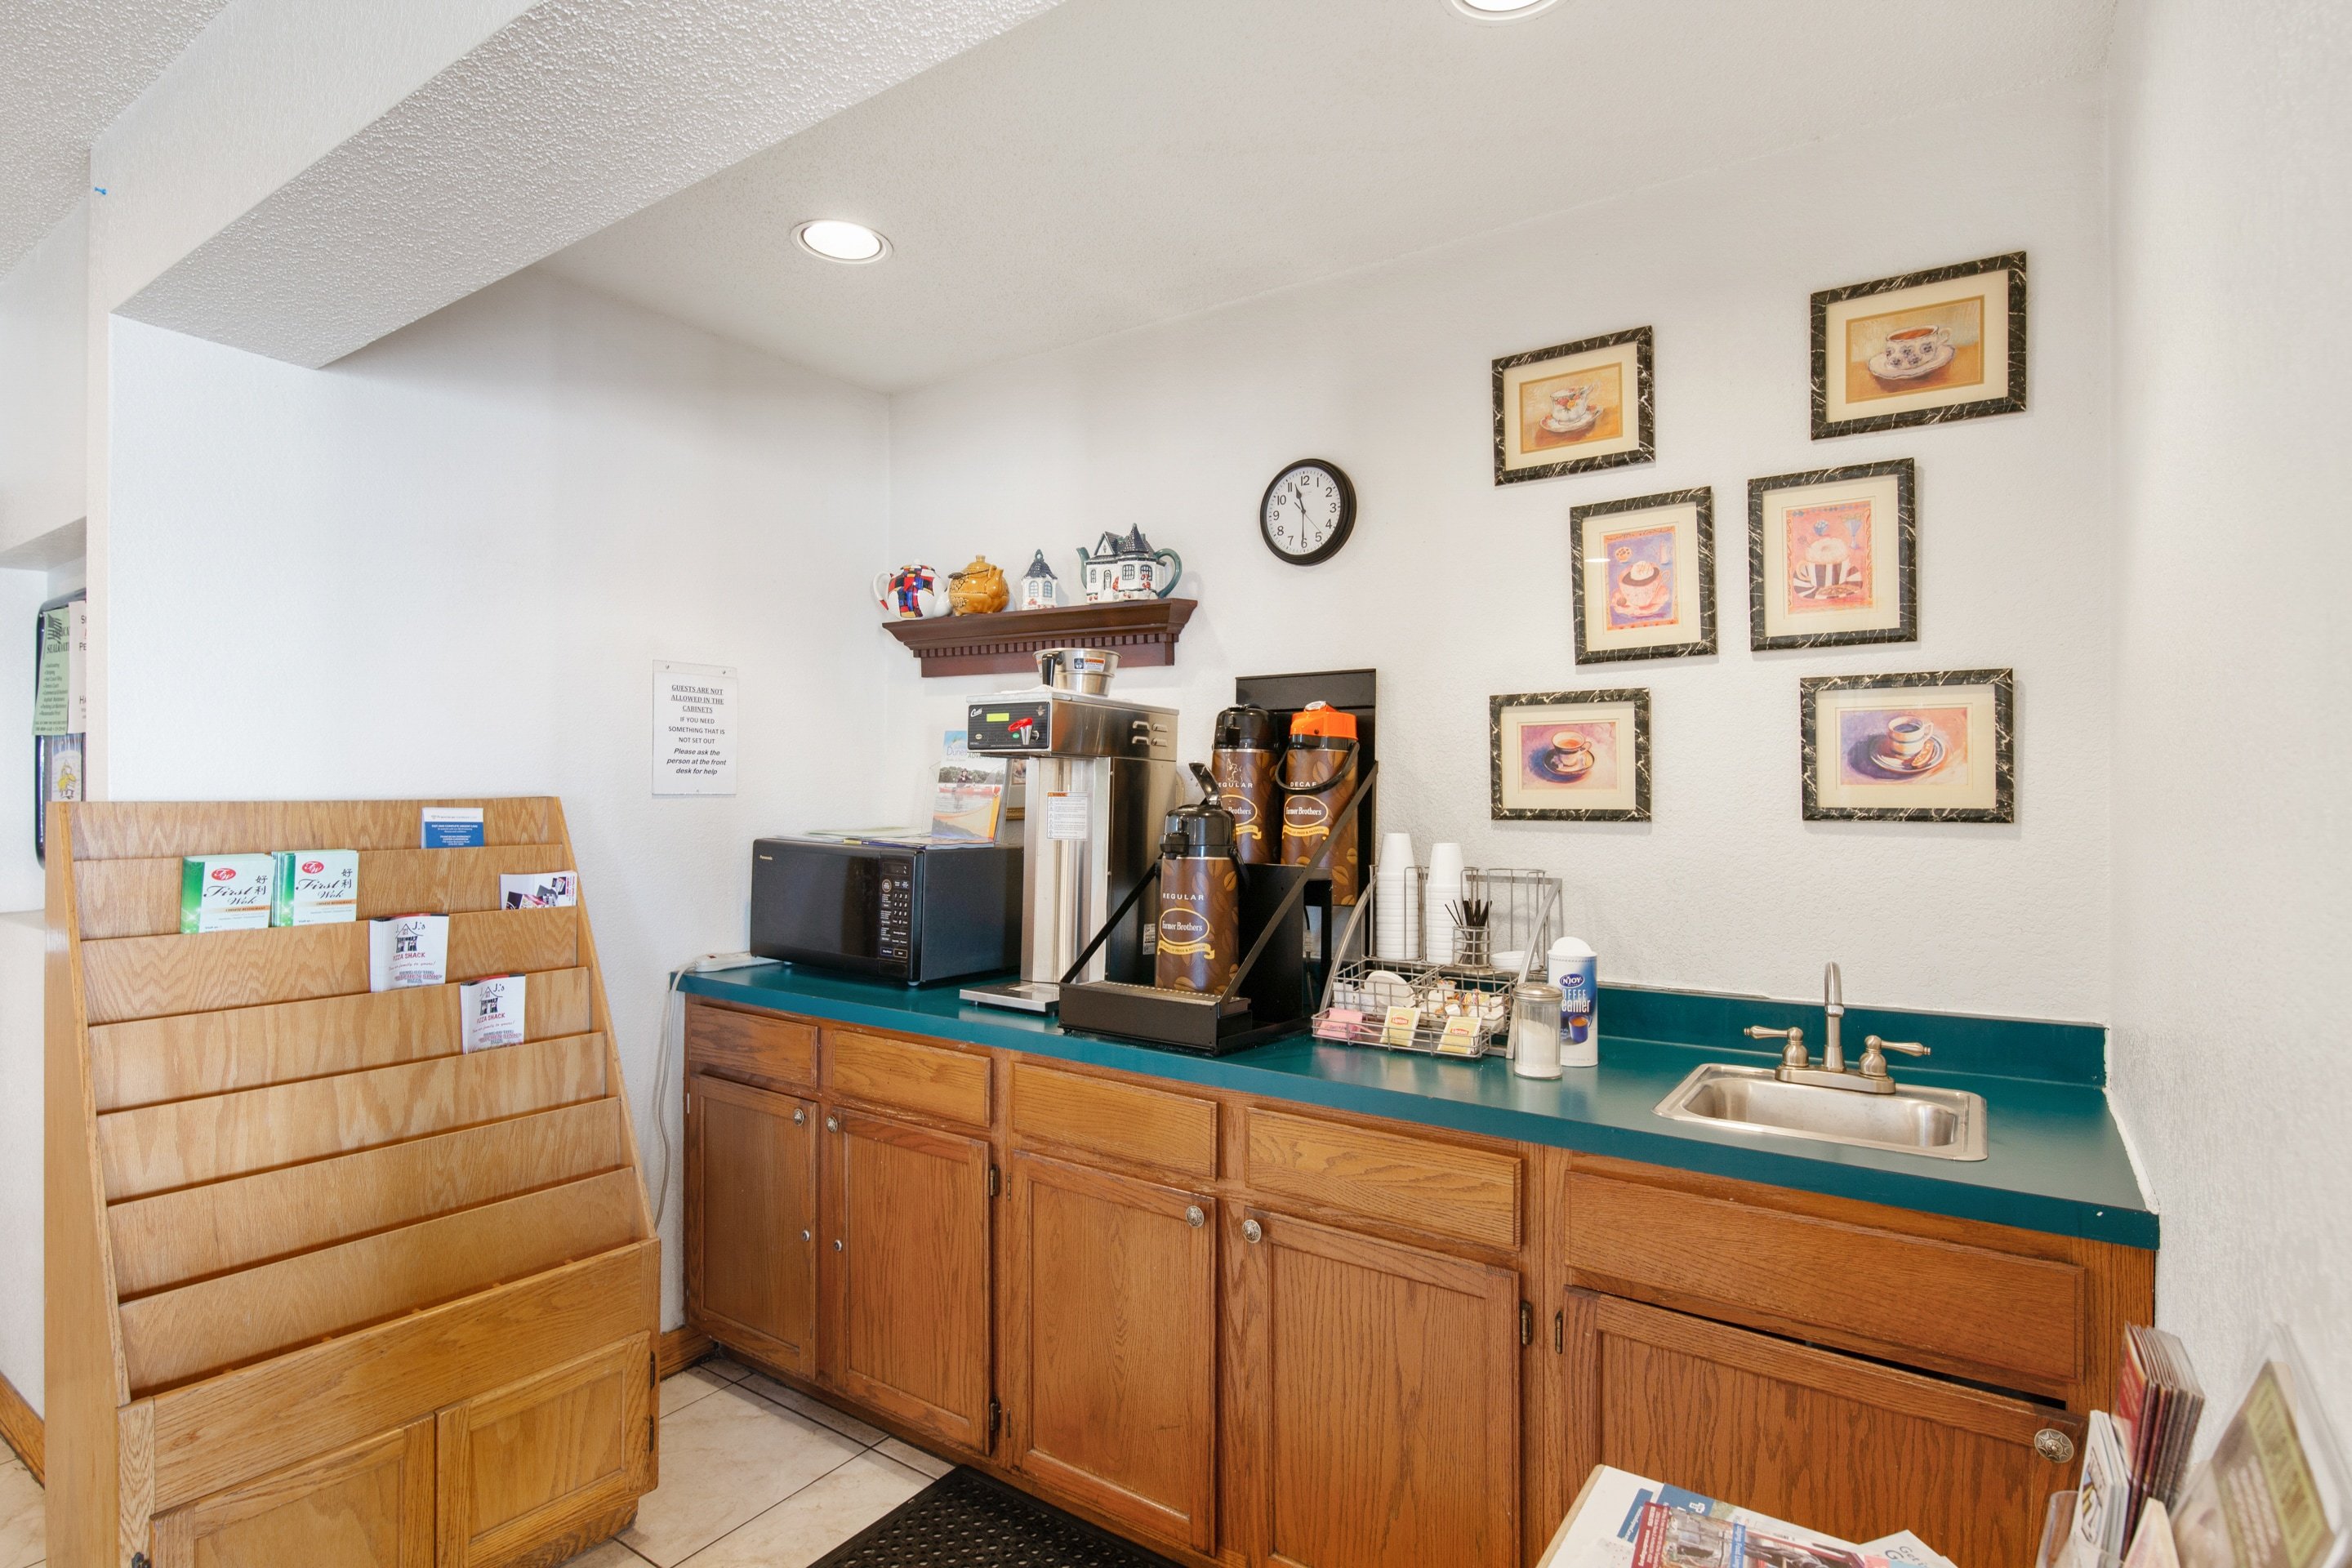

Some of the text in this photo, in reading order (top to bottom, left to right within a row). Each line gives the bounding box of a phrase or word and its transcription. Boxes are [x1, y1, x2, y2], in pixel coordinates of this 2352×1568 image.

[1300, 475, 1310, 486] 12
[1316, 477, 1320, 488] 1
[1288, 482, 1292, 492] 11
[1325, 487, 1333, 497] 2
[1277, 495, 1286, 506] 10
[1330, 503, 1336, 513] 3
[1273, 510, 1279, 520] 9
[1325, 519, 1332, 529] 4
[1277, 526, 1284, 536] 8
[1288, 536, 1294, 546] 7
[1315, 532, 1322, 541] 5
[1301, 538, 1307, 548] 6
[671, 684, 696, 693] GUESTS
[671, 694, 702, 702] ALLOWED
[1228, 807, 1252, 815] Brothers
[1298, 807, 1321, 816] Brothers
[296, 879, 340, 890] First
[203, 885, 253, 897] First
[318, 889, 344, 898] Wok
[228, 896, 257, 905] Wok
[1177, 922, 1203, 931] Brothers
[1563, 989, 1586, 1000] OFFEE
[1561, 999, 1591, 1013] eamer
[488, 1013, 506, 1021] SHACK
[1392, 1017, 1408, 1025] Lipton
[1900, 1546, 1920, 1561] Get
